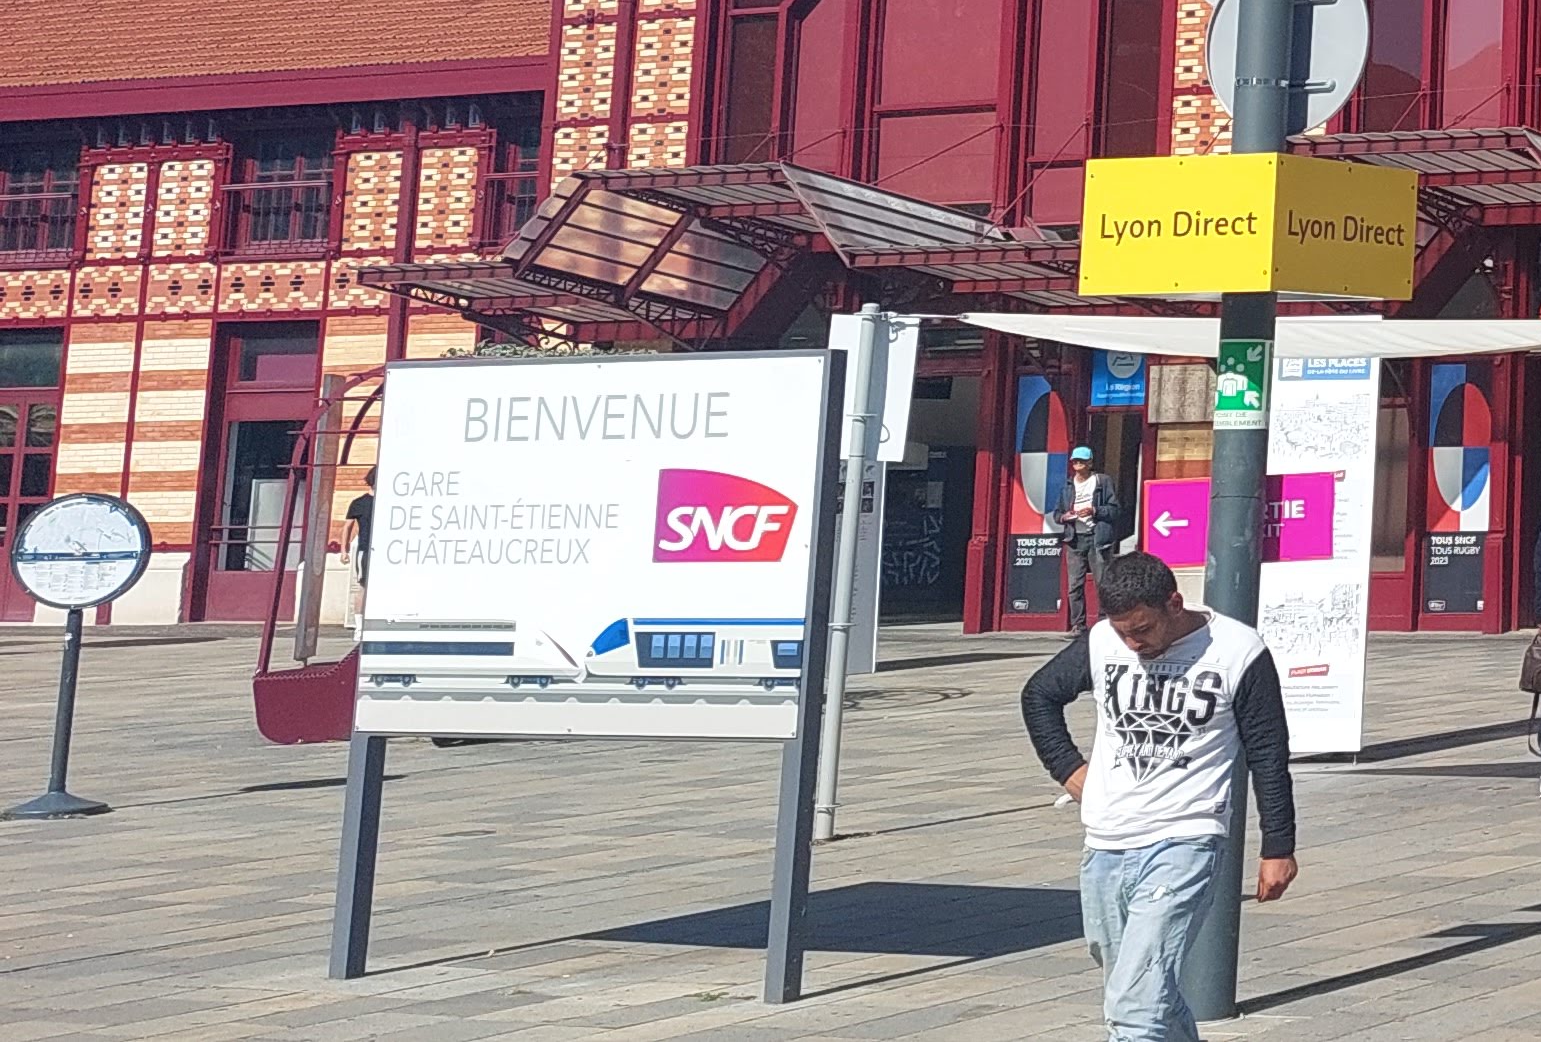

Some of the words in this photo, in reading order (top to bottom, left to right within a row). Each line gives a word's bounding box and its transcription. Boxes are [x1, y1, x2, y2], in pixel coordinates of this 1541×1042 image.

[1099, 212, 1161, 246] Lyon
[1172, 210, 1258, 237] Direct
[1287, 209, 1335, 245] Lyon
[1342, 215, 1406, 247] Direct
[463, 391, 731, 443] BIENVENUE
[391, 470, 462, 498] GARE
[389, 505, 424, 531] DE
[430, 498, 620, 531] SAINT-ÉTIENNE
[657, 504, 790, 552] SNCF
[386, 534, 591, 566] CHÂTEAUCREUX
[1430, 536, 1453, 545] TOUS
[1430, 546, 1453, 555] TOUS
[1104, 663, 1223, 727] KINGS
